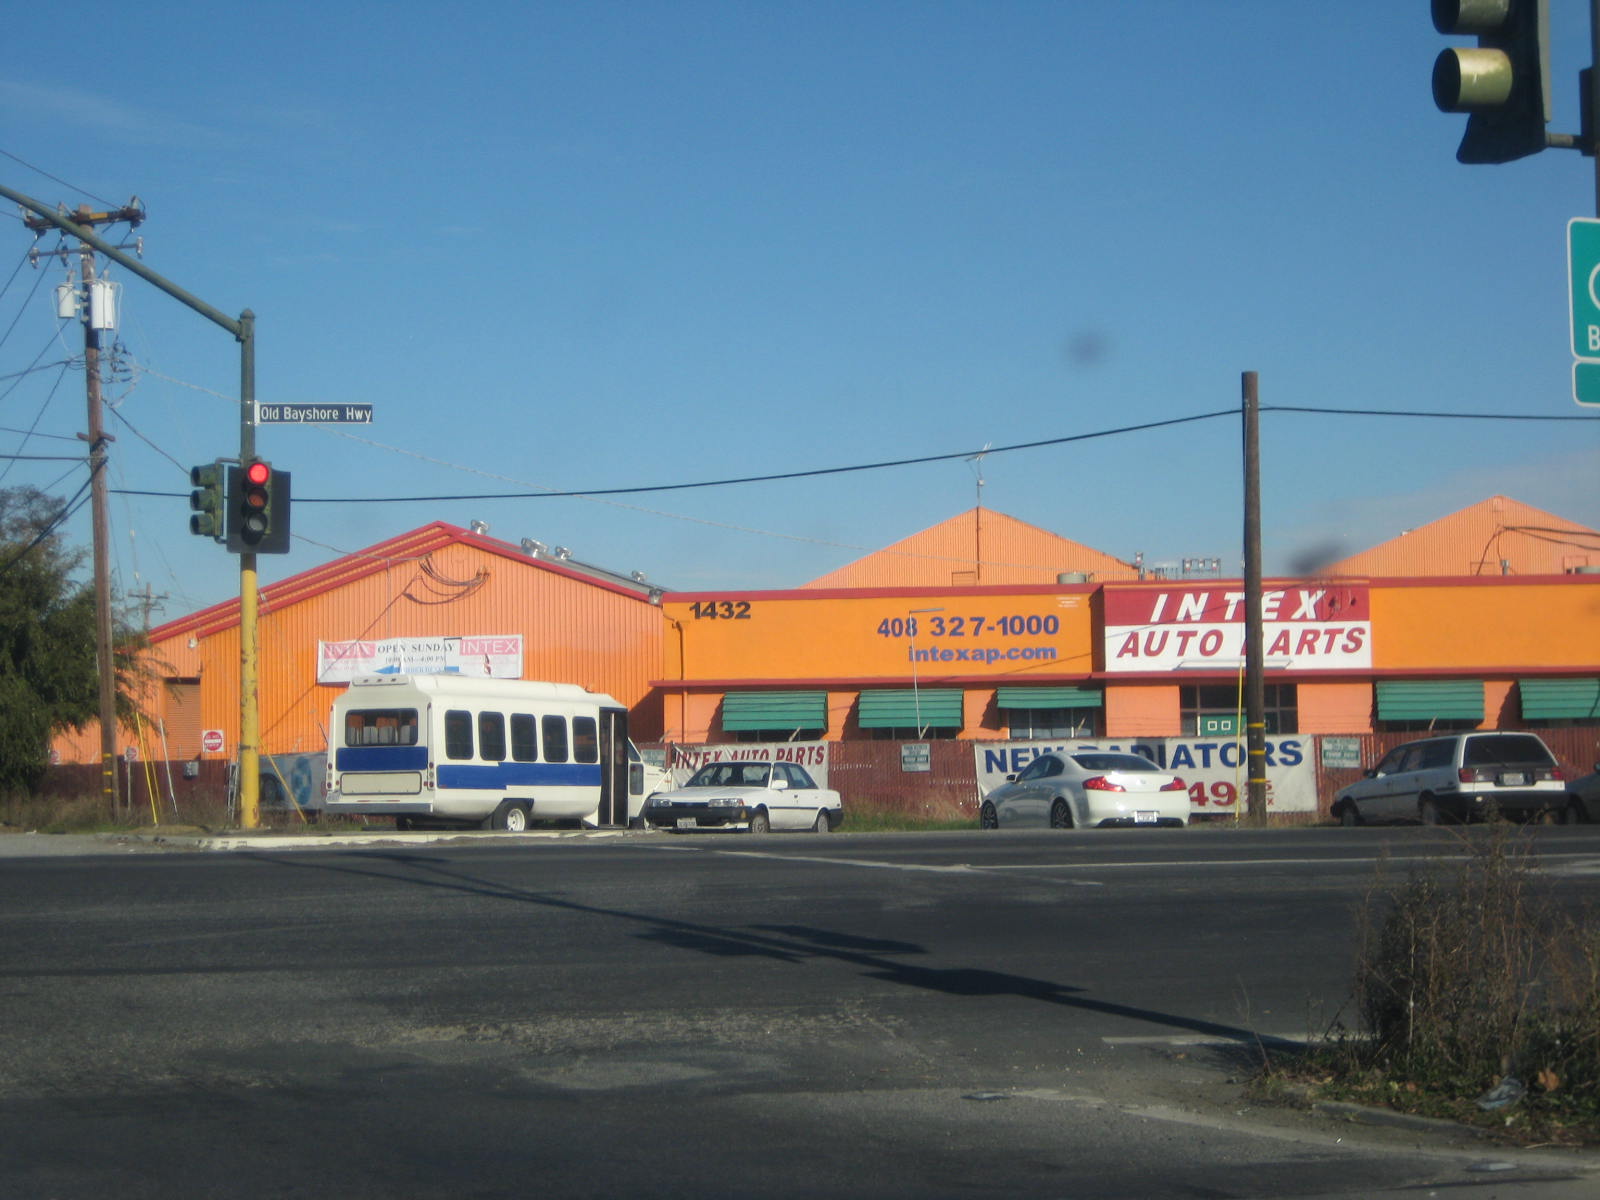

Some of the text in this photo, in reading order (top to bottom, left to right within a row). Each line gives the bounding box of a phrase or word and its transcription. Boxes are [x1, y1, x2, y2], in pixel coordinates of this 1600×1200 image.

[261, 406, 372, 423] Old Bayshore Hwy
[689, 601, 751, 619] 1432
[1150, 590, 1326, 622] INTEX
[877, 615, 1060, 637] 408 327-1000
[377, 643, 406, 653] OPEN
[411, 643, 454, 652] SUNDAY
[462, 640, 516, 654] INTEX
[1116, 627, 1366, 658] AUTO ARTS
[908, 645, 1057, 664] intexap.com
[776, 745, 825, 766] PARTS
[1078, 740, 1303, 770] DIATOS
[1188, 781, 1237, 806] 49
